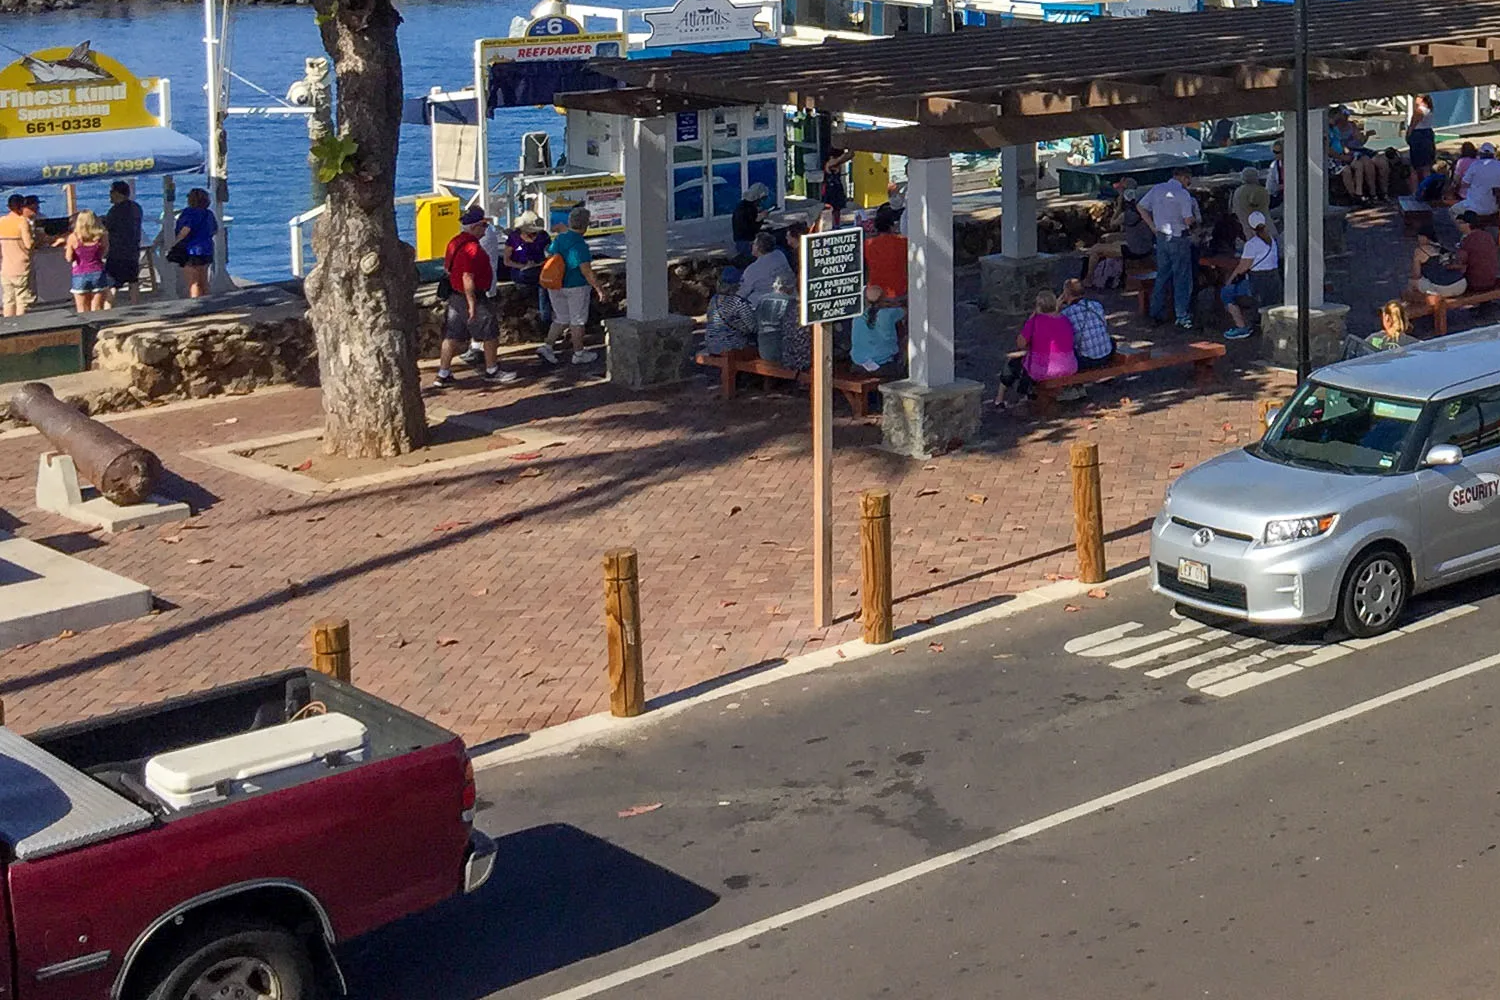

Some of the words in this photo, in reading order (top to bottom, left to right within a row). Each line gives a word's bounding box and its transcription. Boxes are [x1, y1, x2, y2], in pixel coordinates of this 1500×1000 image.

[547, 17, 563, 34] 6
[517, 45, 592, 58] REEFDANCER
[0, 88, 71, 108] Finest
[75, 82, 127, 102] Kind
[26, 117, 102, 134] 661-0338
[811, 238, 821, 249] 15
[823, 234, 857, 247] MINUTE
[813, 248, 831, 258] BUS
[832, 243, 856, 255] STOP
[814, 253, 854, 267] PARKING
[821, 264, 847, 275] ONLY
[809, 282, 822, 291] NO
[823, 276, 859, 288] PARKING
[811, 301, 832, 312] TOW
[832, 296, 857, 308] AWAY
[822, 308, 846, 318] ZONE
[1453, 480, 1500, 507] SECURITY
